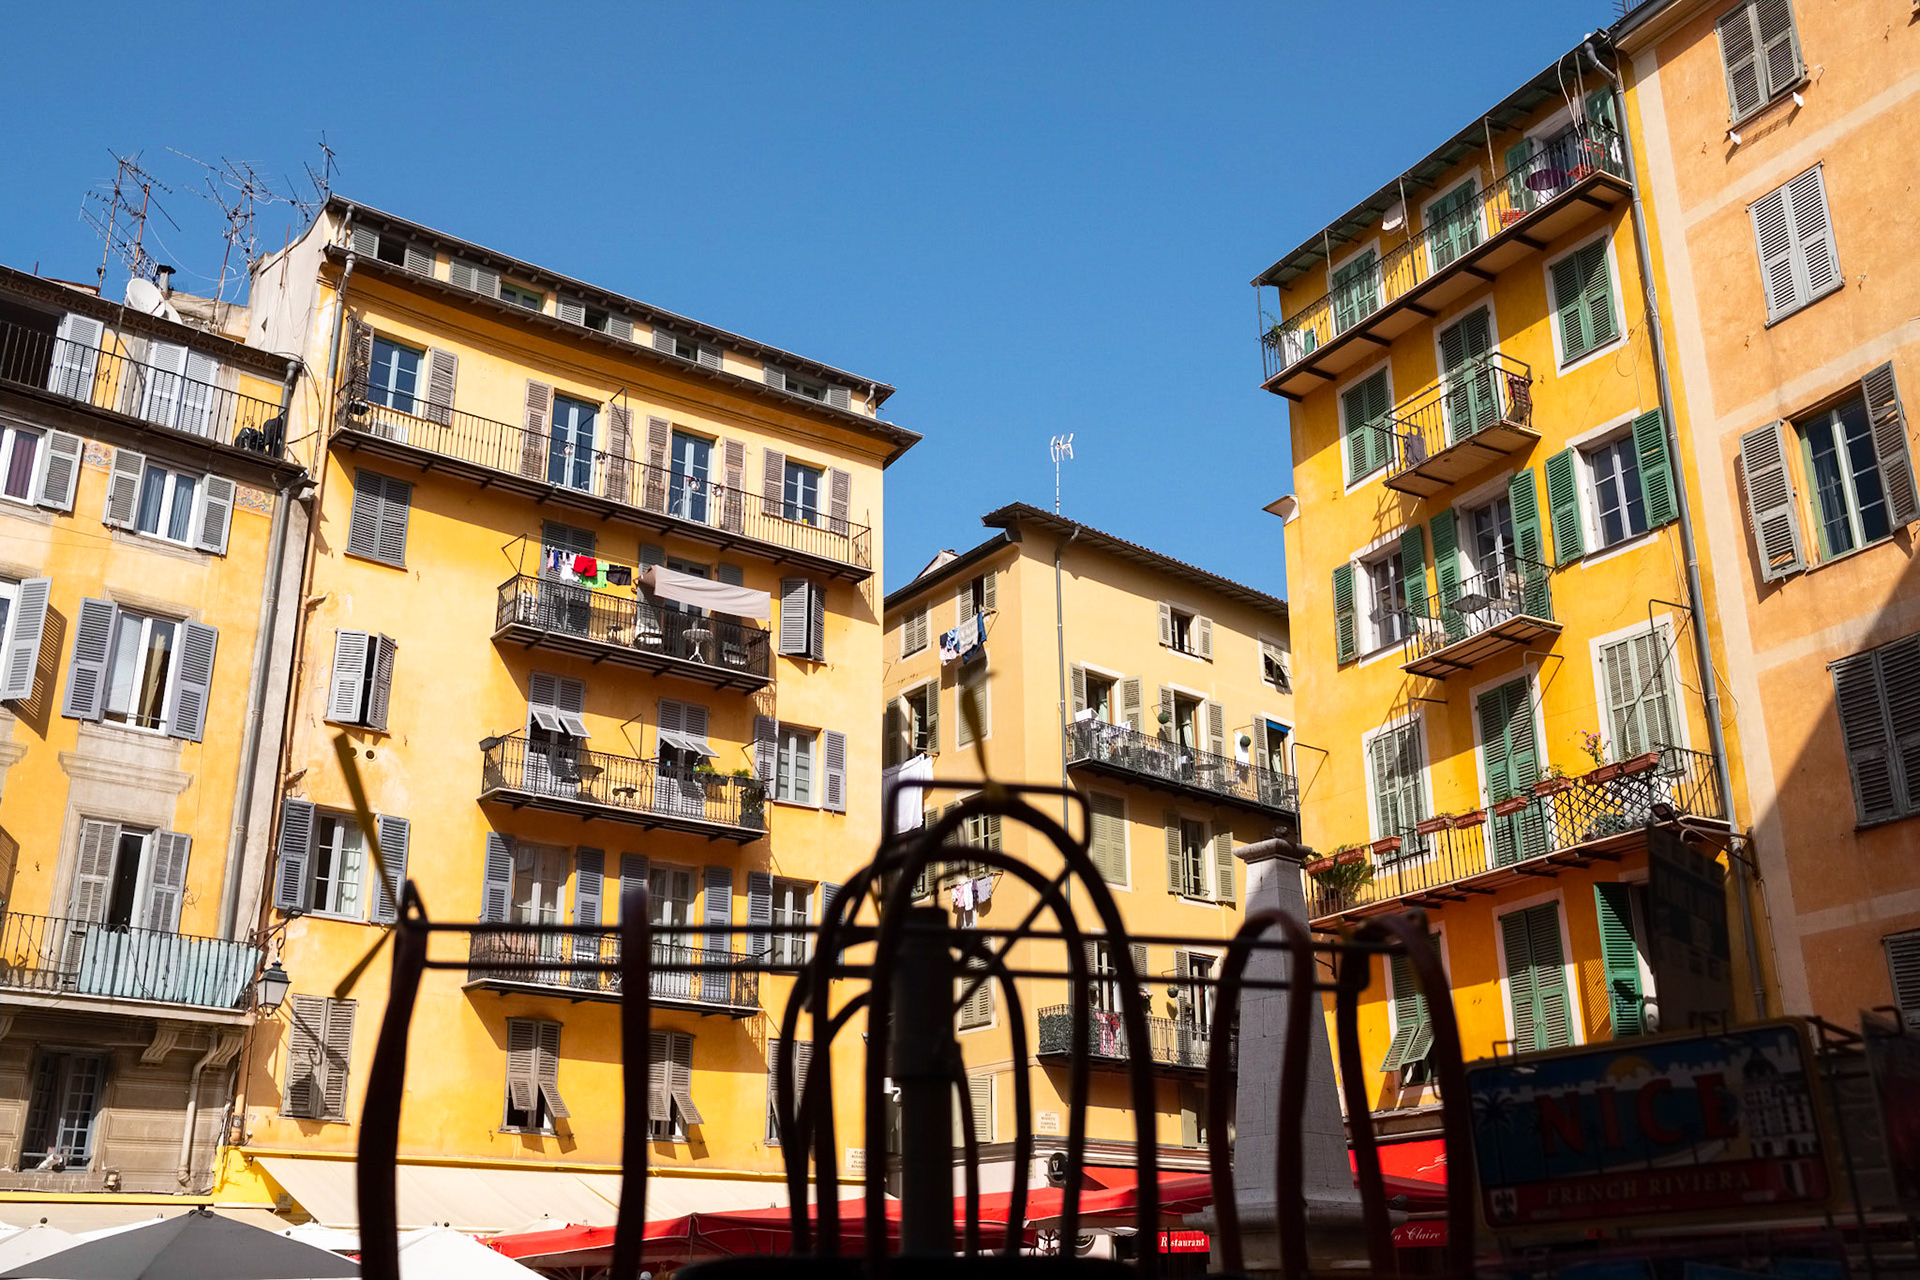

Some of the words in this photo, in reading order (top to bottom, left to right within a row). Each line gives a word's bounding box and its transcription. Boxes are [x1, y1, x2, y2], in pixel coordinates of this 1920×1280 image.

[1534, 1072, 1739, 1157] NICE
[1547, 1178, 1638, 1206] FRENCH
[1649, 1168, 1751, 1199] RIVIERA
[1160, 1236, 1205, 1247] Rstaurant
[1405, 1227, 1441, 1241] Claire
